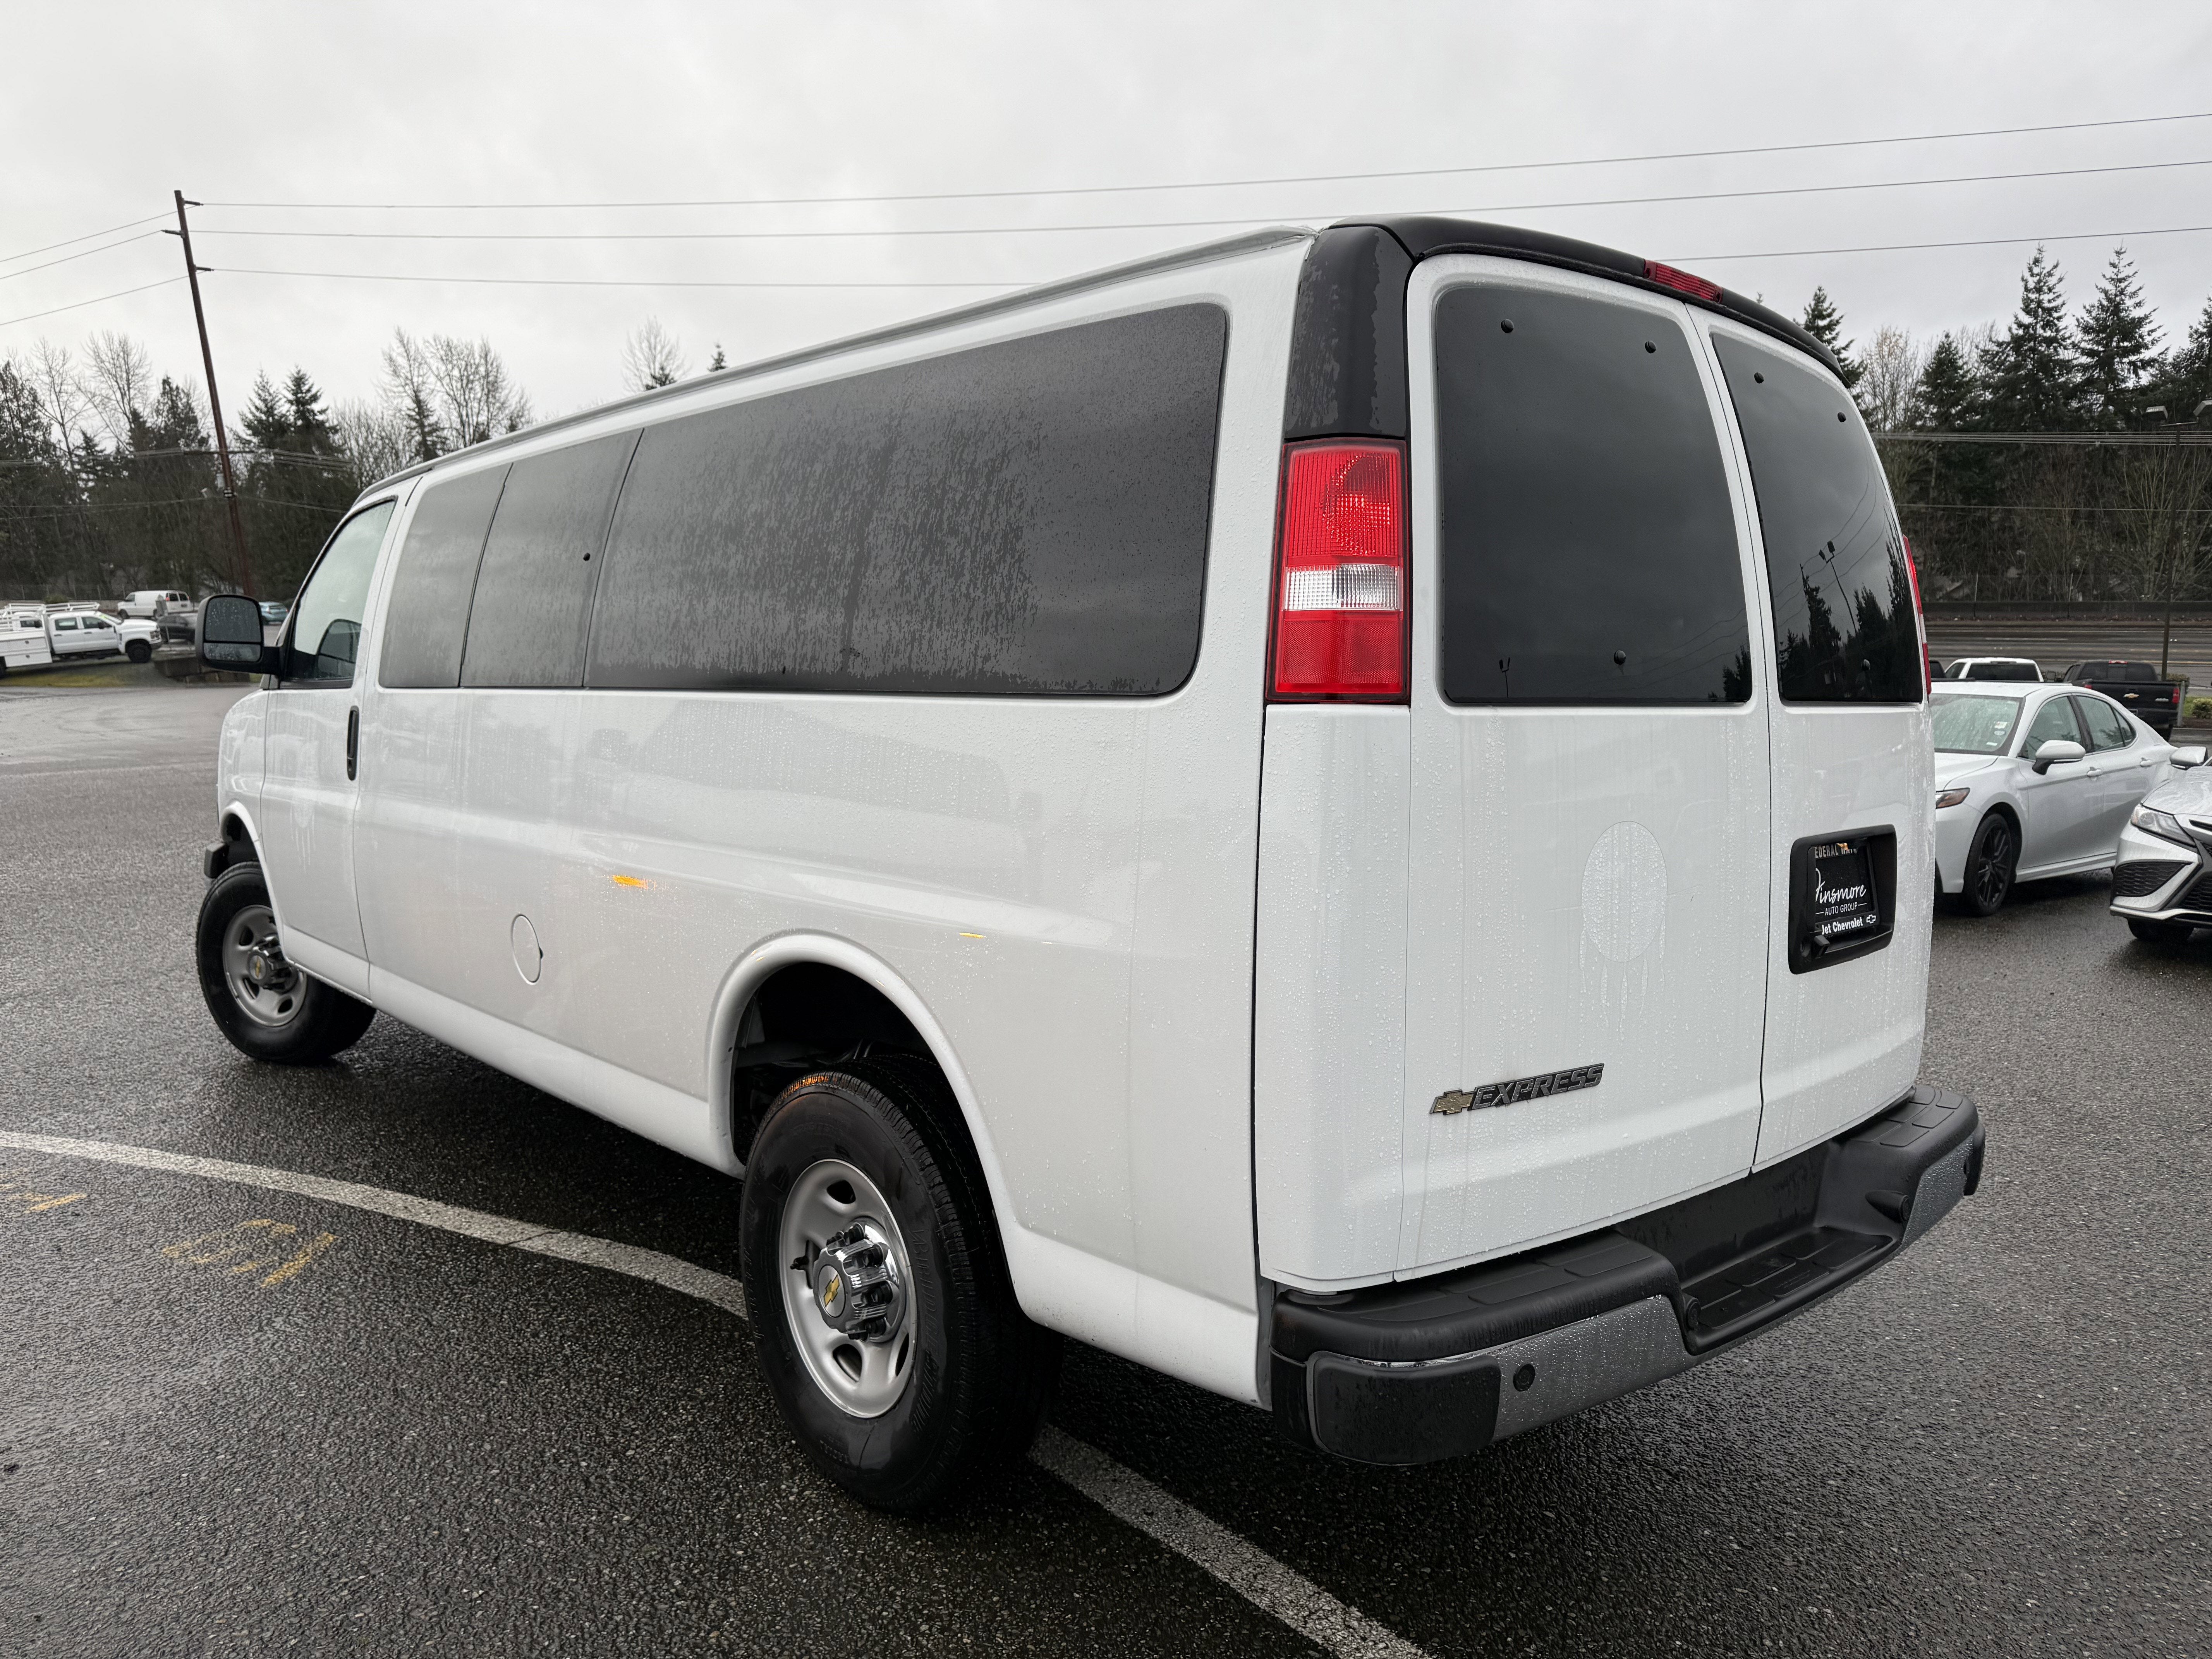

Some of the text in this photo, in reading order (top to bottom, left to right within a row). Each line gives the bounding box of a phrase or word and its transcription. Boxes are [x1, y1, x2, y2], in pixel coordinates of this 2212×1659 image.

[1814, 844, 1839, 858] EDERAL
[1825, 902, 1858, 916] AUTO GROUP
[1822, 917, 1863, 935] Jet Chevrolet
[1472, 1065, 1604, 1110] EXPRESS
